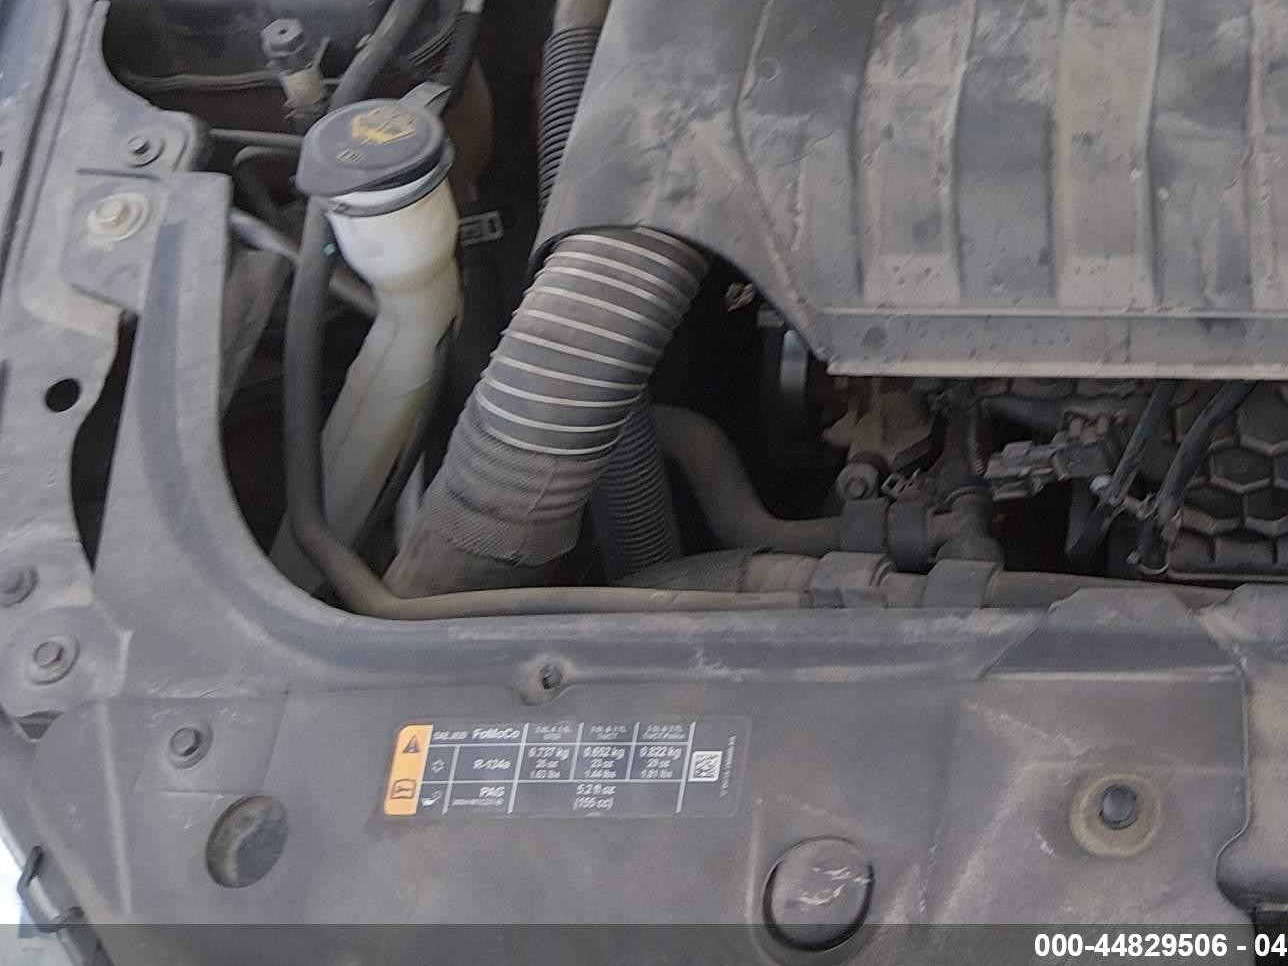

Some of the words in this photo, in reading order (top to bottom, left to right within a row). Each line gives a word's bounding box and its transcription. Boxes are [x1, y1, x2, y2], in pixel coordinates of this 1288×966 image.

[472, 728, 520, 739] FoMoCo
[555, 747, 570, 760] kg
[611, 747, 626, 760] kg
[667, 747, 682, 760] kg
[473, 759, 511, 769] R-134a
[547, 760, 559, 769] oz
[602, 760, 615, 768] oz
[658, 760, 671, 768] oz
[479, 787, 505, 797] PAG
